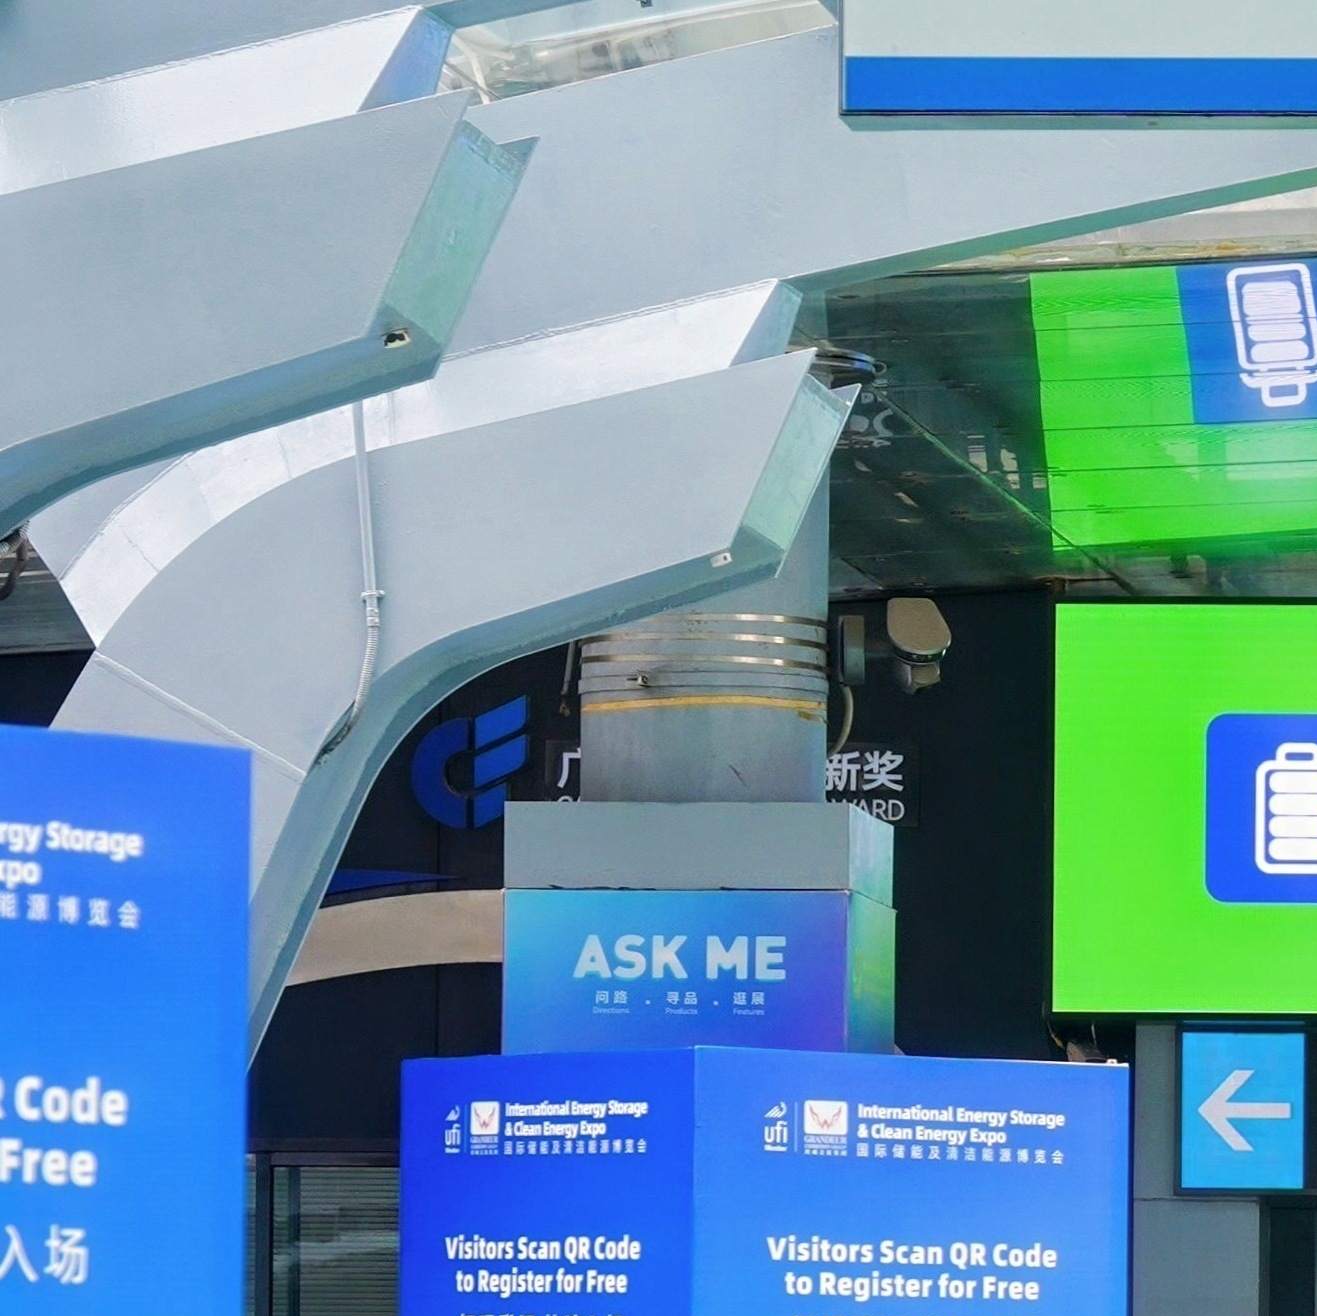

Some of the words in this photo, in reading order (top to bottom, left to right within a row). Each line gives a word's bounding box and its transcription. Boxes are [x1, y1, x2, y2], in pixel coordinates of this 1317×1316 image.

[45, 820, 145, 862] Storage
[572, 934, 689, 980] ASK
[706, 935, 786, 981] ME
[14, 1075, 129, 1127] Code
[505, 1101, 570, 1117] International
[571, 1101, 607, 1119] Energy
[608, 1100, 648, 1118] Storage
[857, 1103, 954, 1123] International
[956, 1106, 1008, 1128] Energy
[1010, 1107, 1066, 1130] Storage
[514, 1121, 542, 1136] Clean
[543, 1121, 579, 1138] Energy
[580, 1121, 606, 1138] Expo
[857, 1123, 868, 1138] &
[870, 1123, 913, 1141] Clean
[915, 1124, 967, 1145] Energy
[968, 1127, 1007, 1147] Expo
[445, 1234, 514, 1260] Visitors
[517, 1235, 561, 1260] Scan
[564, 1235, 591, 1264] QR
[594, 1233, 641, 1260] Code
[766, 1235, 874, 1263] Visitors
[879, 1240, 943, 1265] Scan
[949, 1242, 987, 1269] QR
[992, 1242, 1058, 1269] Code
[455, 1269, 474, 1293] to
[477, 1267, 553, 1299] Register
[555, 1267, 584, 1293] for
[586, 1269, 628, 1293] Free
[784, 1272, 813, 1296] to
[819, 1271, 933, 1302] Register
[938, 1273, 977, 1299] for
[982, 1275, 1040, 1301] Free
